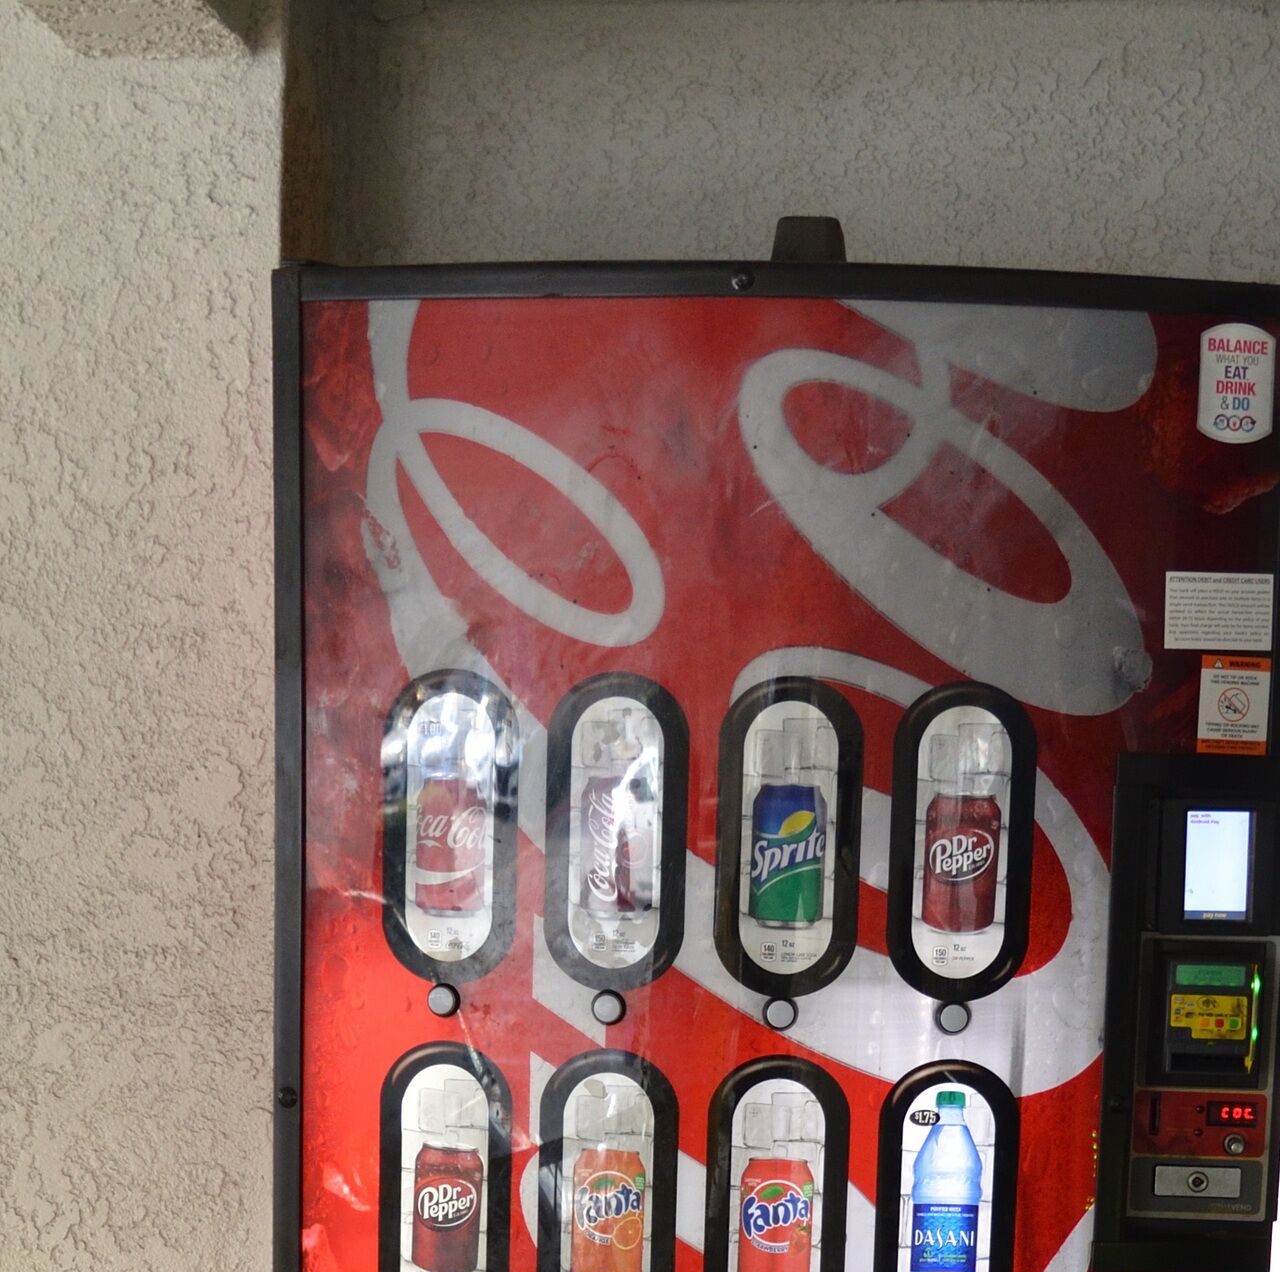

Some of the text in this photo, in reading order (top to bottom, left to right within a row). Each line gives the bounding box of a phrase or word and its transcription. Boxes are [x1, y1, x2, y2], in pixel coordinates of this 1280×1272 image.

[1207, 337, 1269, 356] BALANCE
[1215, 353, 1260, 366] WHAT YOU
[1216, 380, 1256, 396] DRINK
[1220, 395, 1250, 411] & DO
[1229, 661, 1261, 669] WARNING
[751, 826, 825, 882] Sprite
[952, 834, 978, 856] Dr
[931, 839, 991, 876] Pepper
[1202, 912, 1214, 920] pay
[763, 944, 774, 952] 140
[914, 1111, 936, 1124] $1.75
[438, 1184, 462, 1204] Dr
[420, 1186, 474, 1222] Pepper
[575, 1182, 641, 1231] Fanta
[742, 1190, 811, 1240] Fanta
[914, 1228, 974, 1249] DASANI
